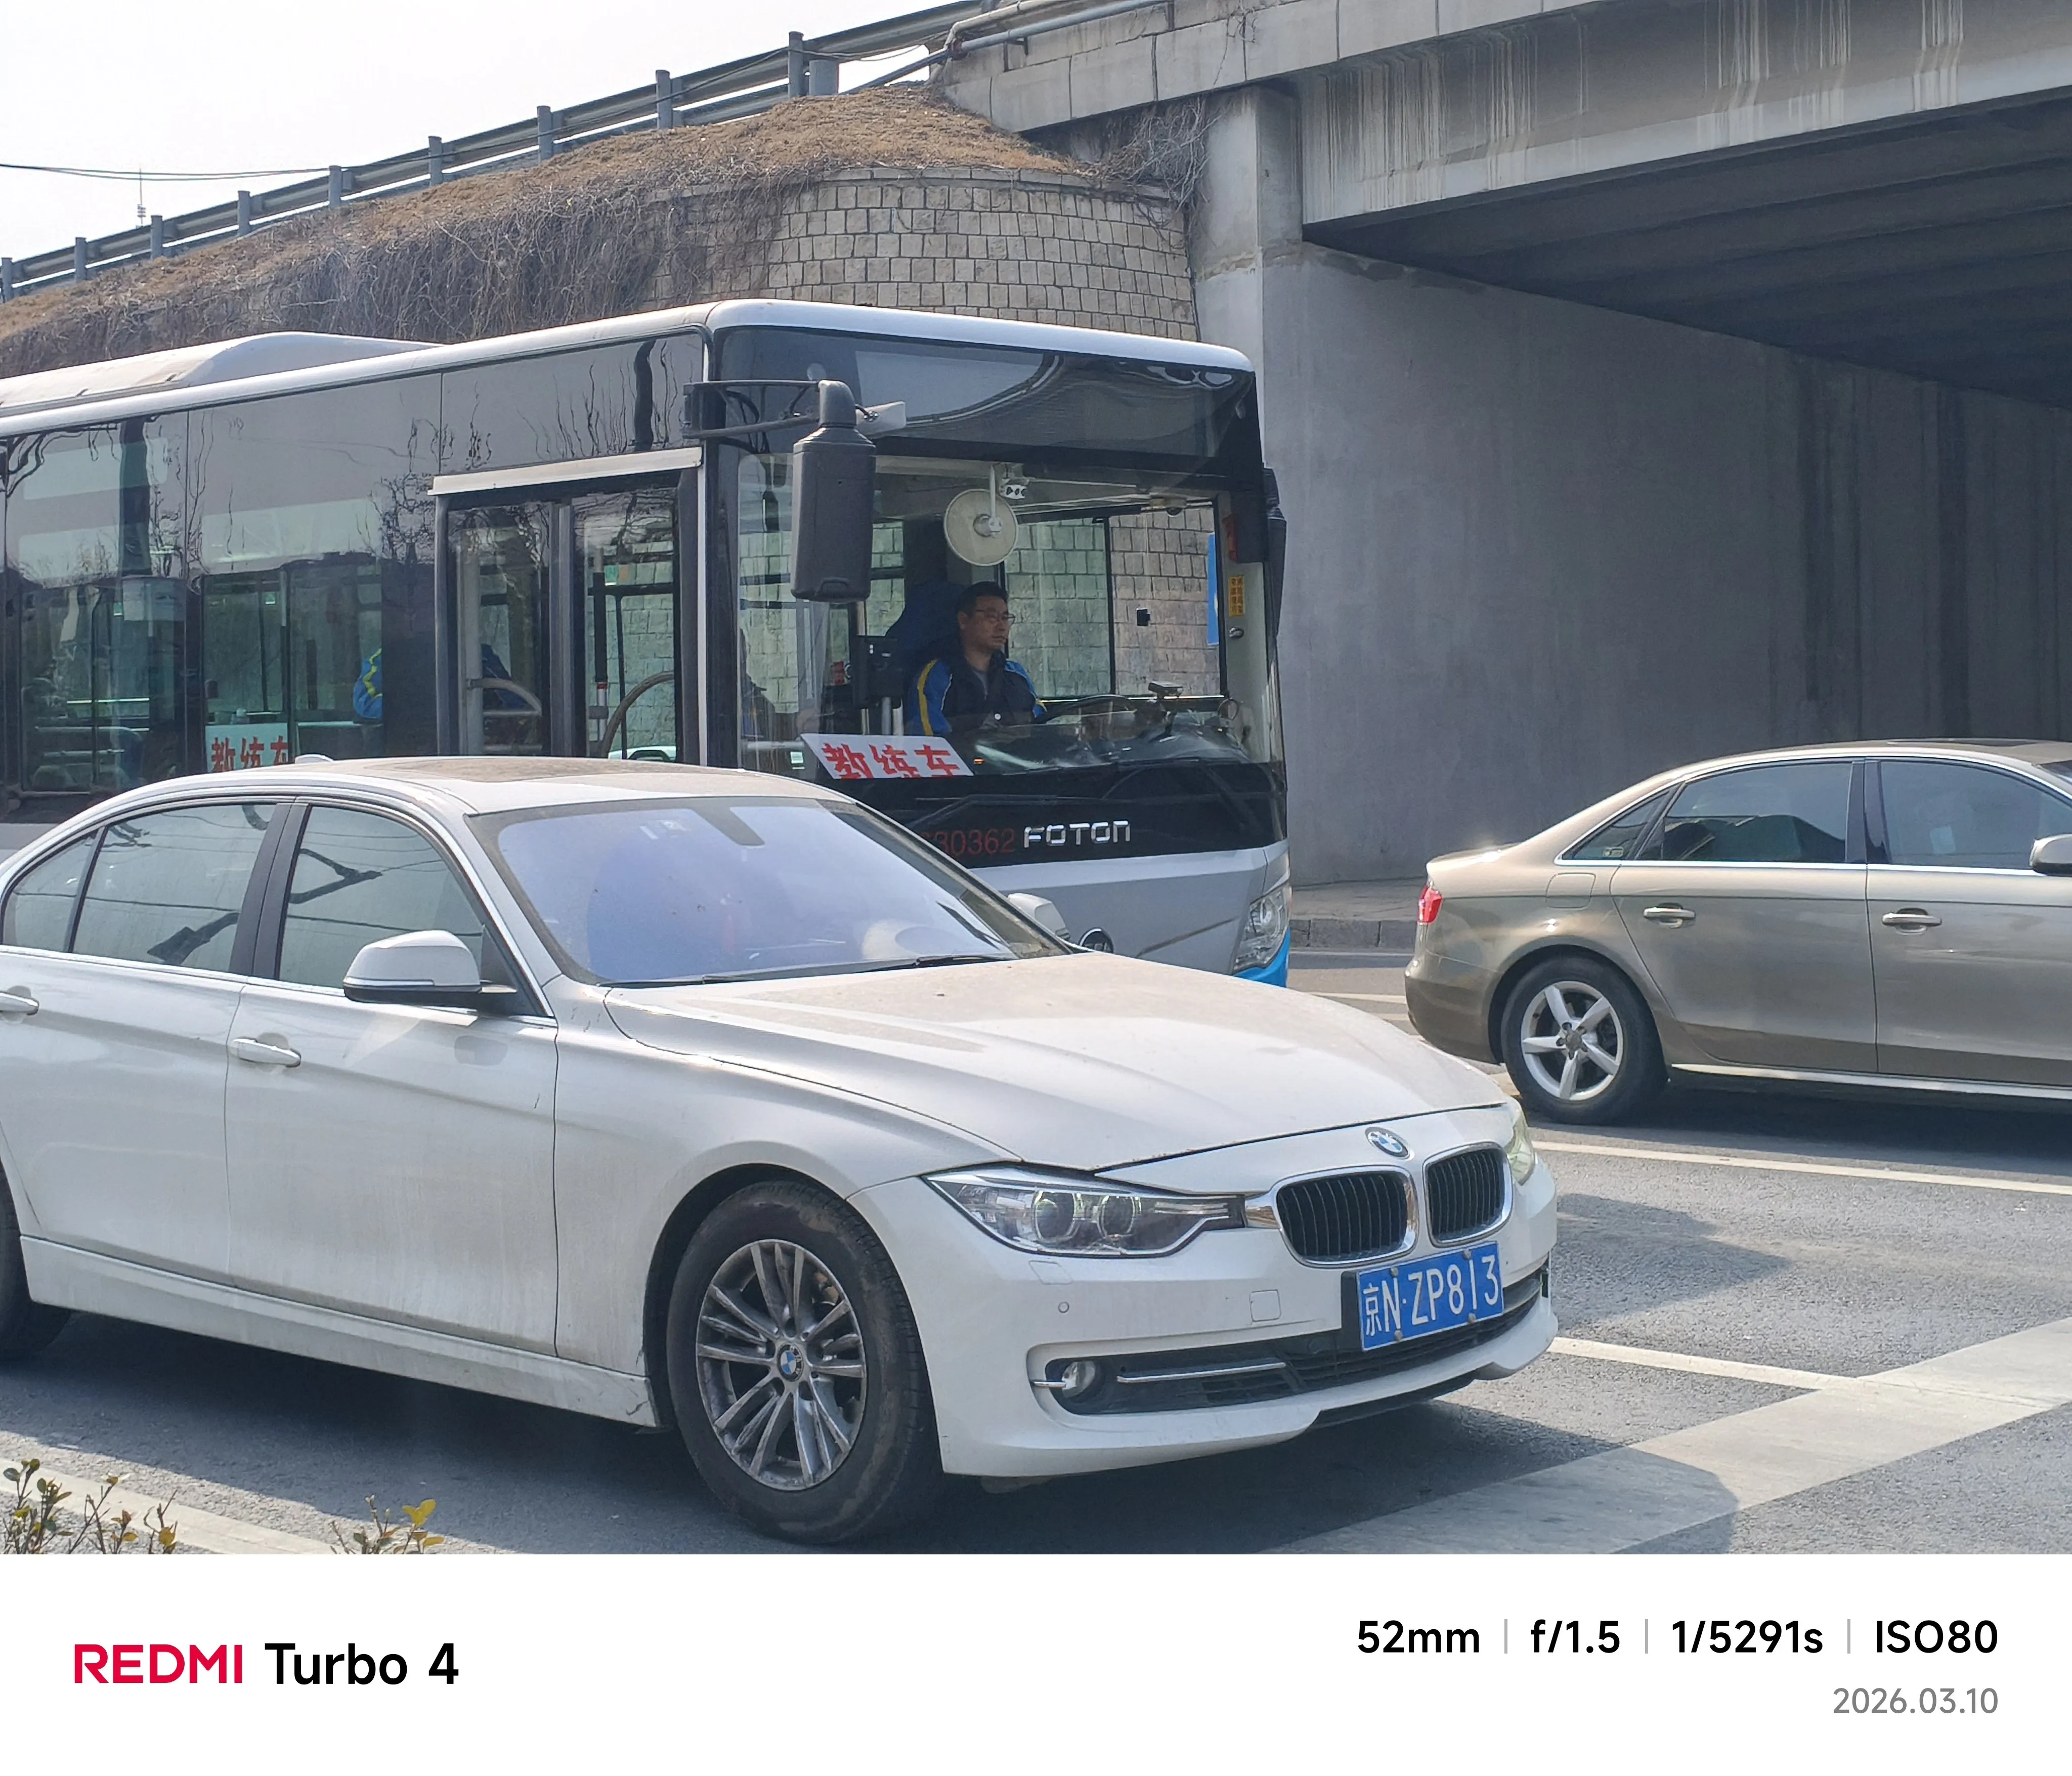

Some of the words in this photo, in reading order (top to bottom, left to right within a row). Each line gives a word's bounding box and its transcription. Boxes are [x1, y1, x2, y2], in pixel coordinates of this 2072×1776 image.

[822, 742, 960, 779] 教练车
[922, 828, 1015, 857] 30362
[1024, 821, 1131, 848] FOTON
